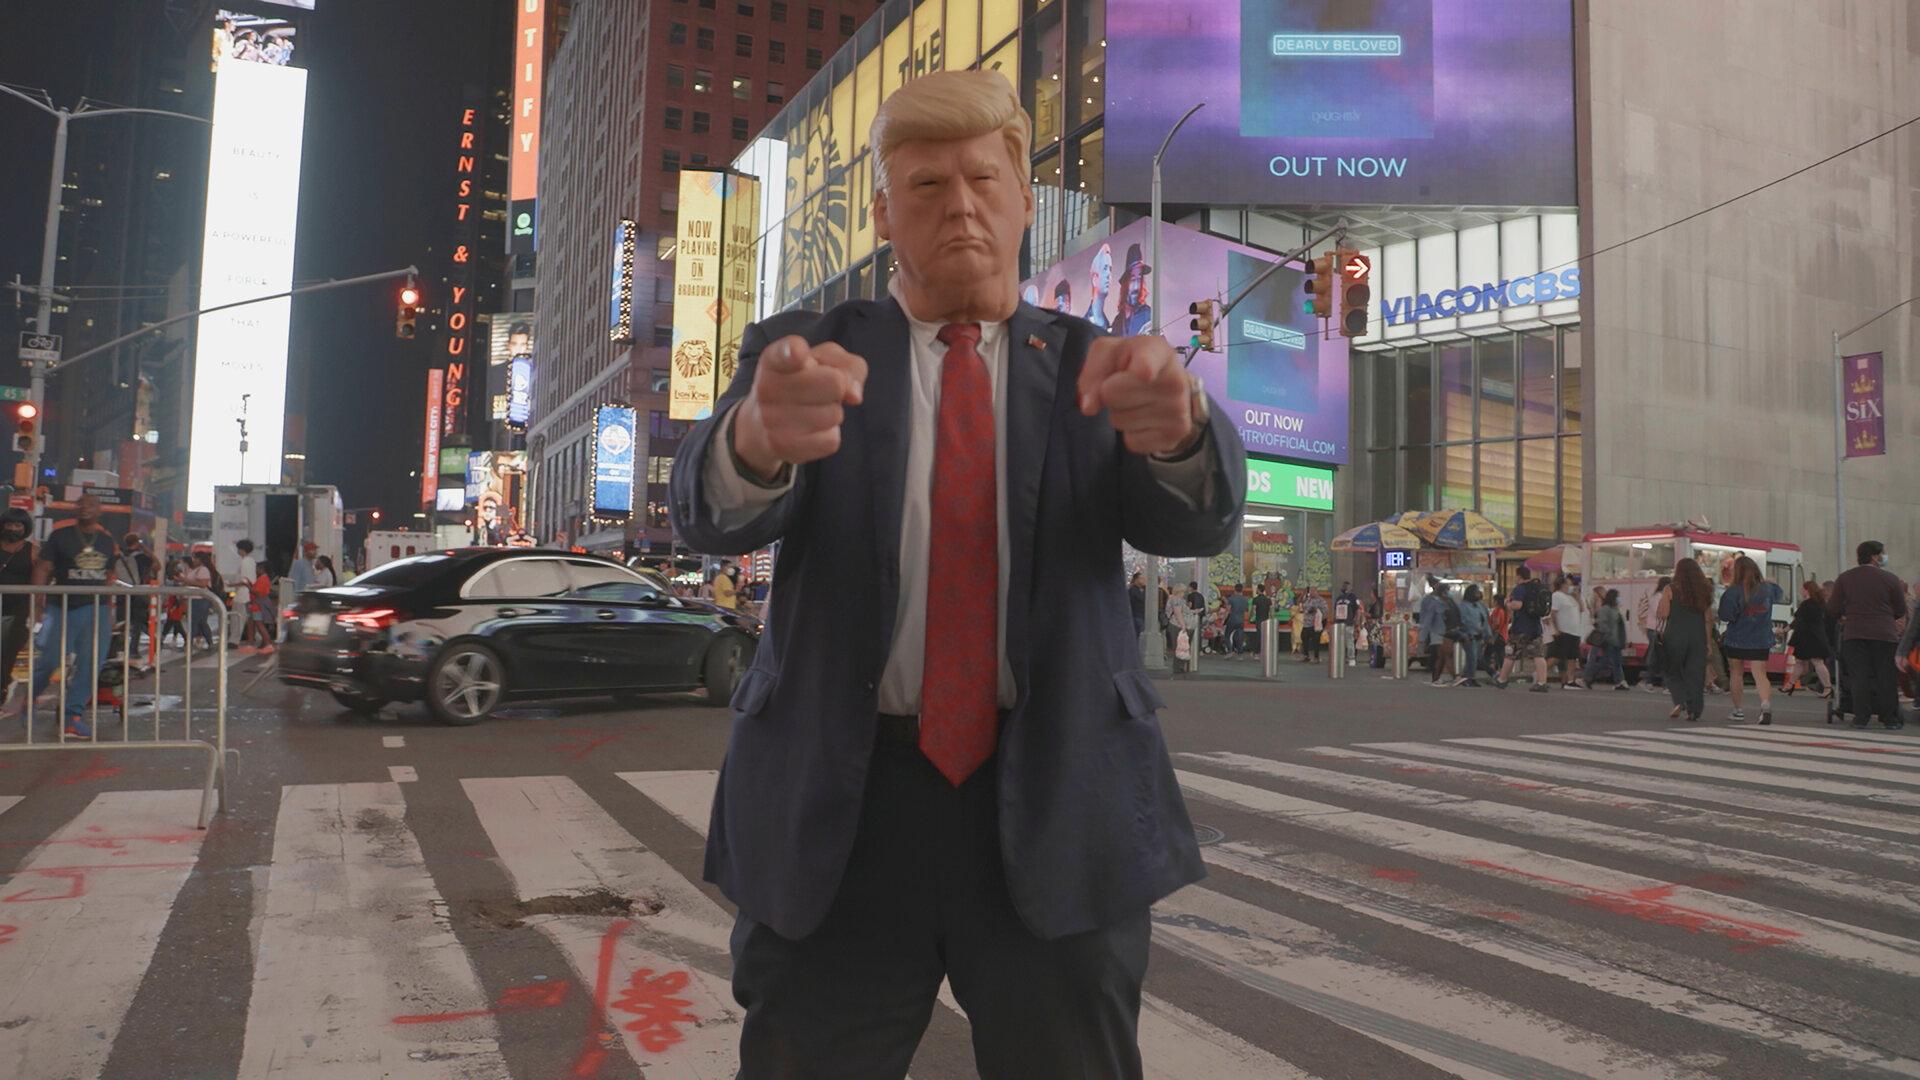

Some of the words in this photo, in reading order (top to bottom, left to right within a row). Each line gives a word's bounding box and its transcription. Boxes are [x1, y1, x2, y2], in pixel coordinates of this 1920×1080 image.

[1277, 39, 1329, 51] DEARLY
[1333, 39, 1397, 51] BELOVED
[898, 28, 940, 87] THE
[457, 108, 475, 224] ERNST
[1269, 156, 1328, 177] OUT
[1337, 157, 1408, 178] NOW
[687, 220, 713, 239] NOW
[680, 239, 717, 256] PLAYING
[691, 261, 704, 278] ON
[678, 283, 715, 298] BROADWAY
[1380, 268, 1581, 327] VIACOMCBS
[446, 287, 466, 407] YOUNG
[1245, 409, 1271, 427] OUT
[1274, 414, 1304, 433] NOW
[1238, 427, 1336, 456] HTRYOFFICIAL.COM
[1247, 468, 1271, 494] DS
[1295, 475, 1334, 500] NEW
[1252, 542, 1294, 555] MINIONS
